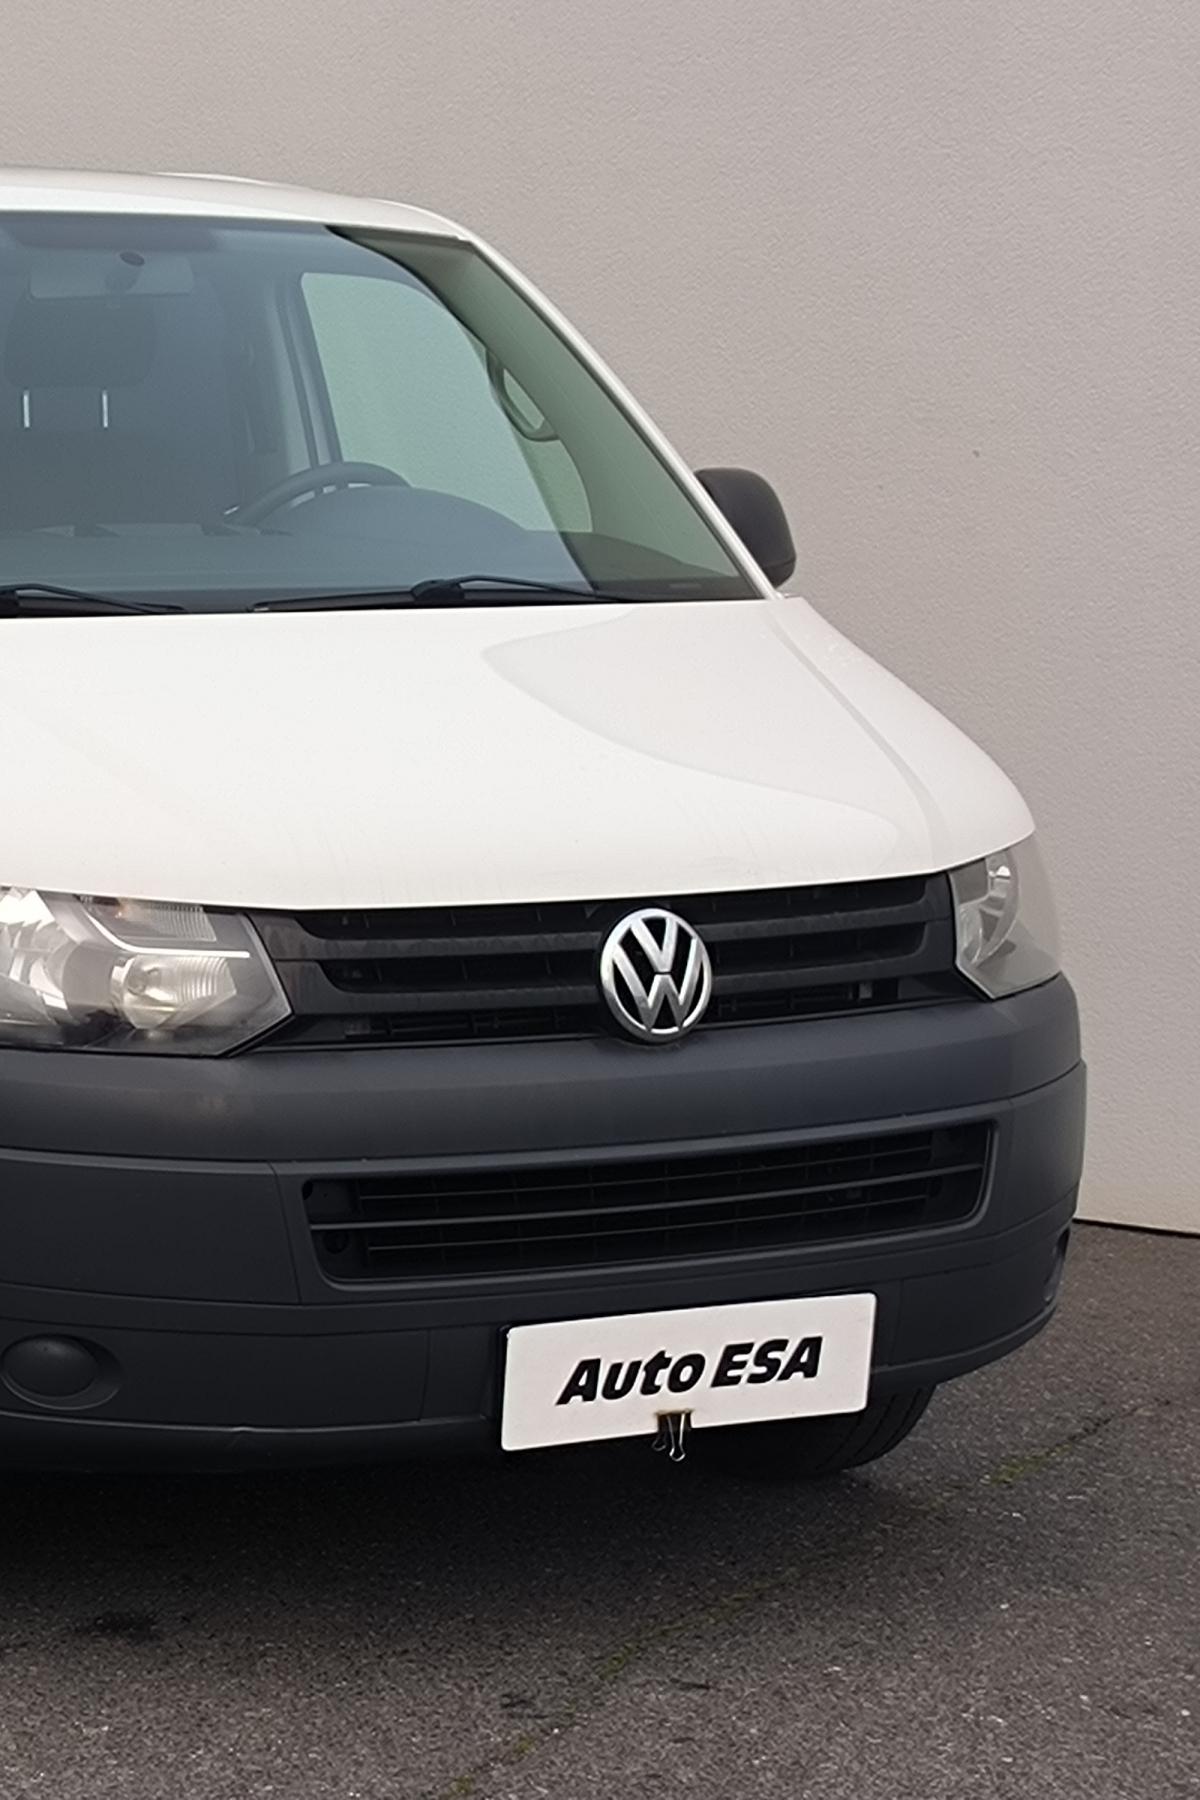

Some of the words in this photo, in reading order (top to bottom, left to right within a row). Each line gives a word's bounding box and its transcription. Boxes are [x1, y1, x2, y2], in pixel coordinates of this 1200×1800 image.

[606, 912, 707, 1036] VW
[555, 1350, 706, 1406] Auto
[711, 1335, 823, 1388] ESA
